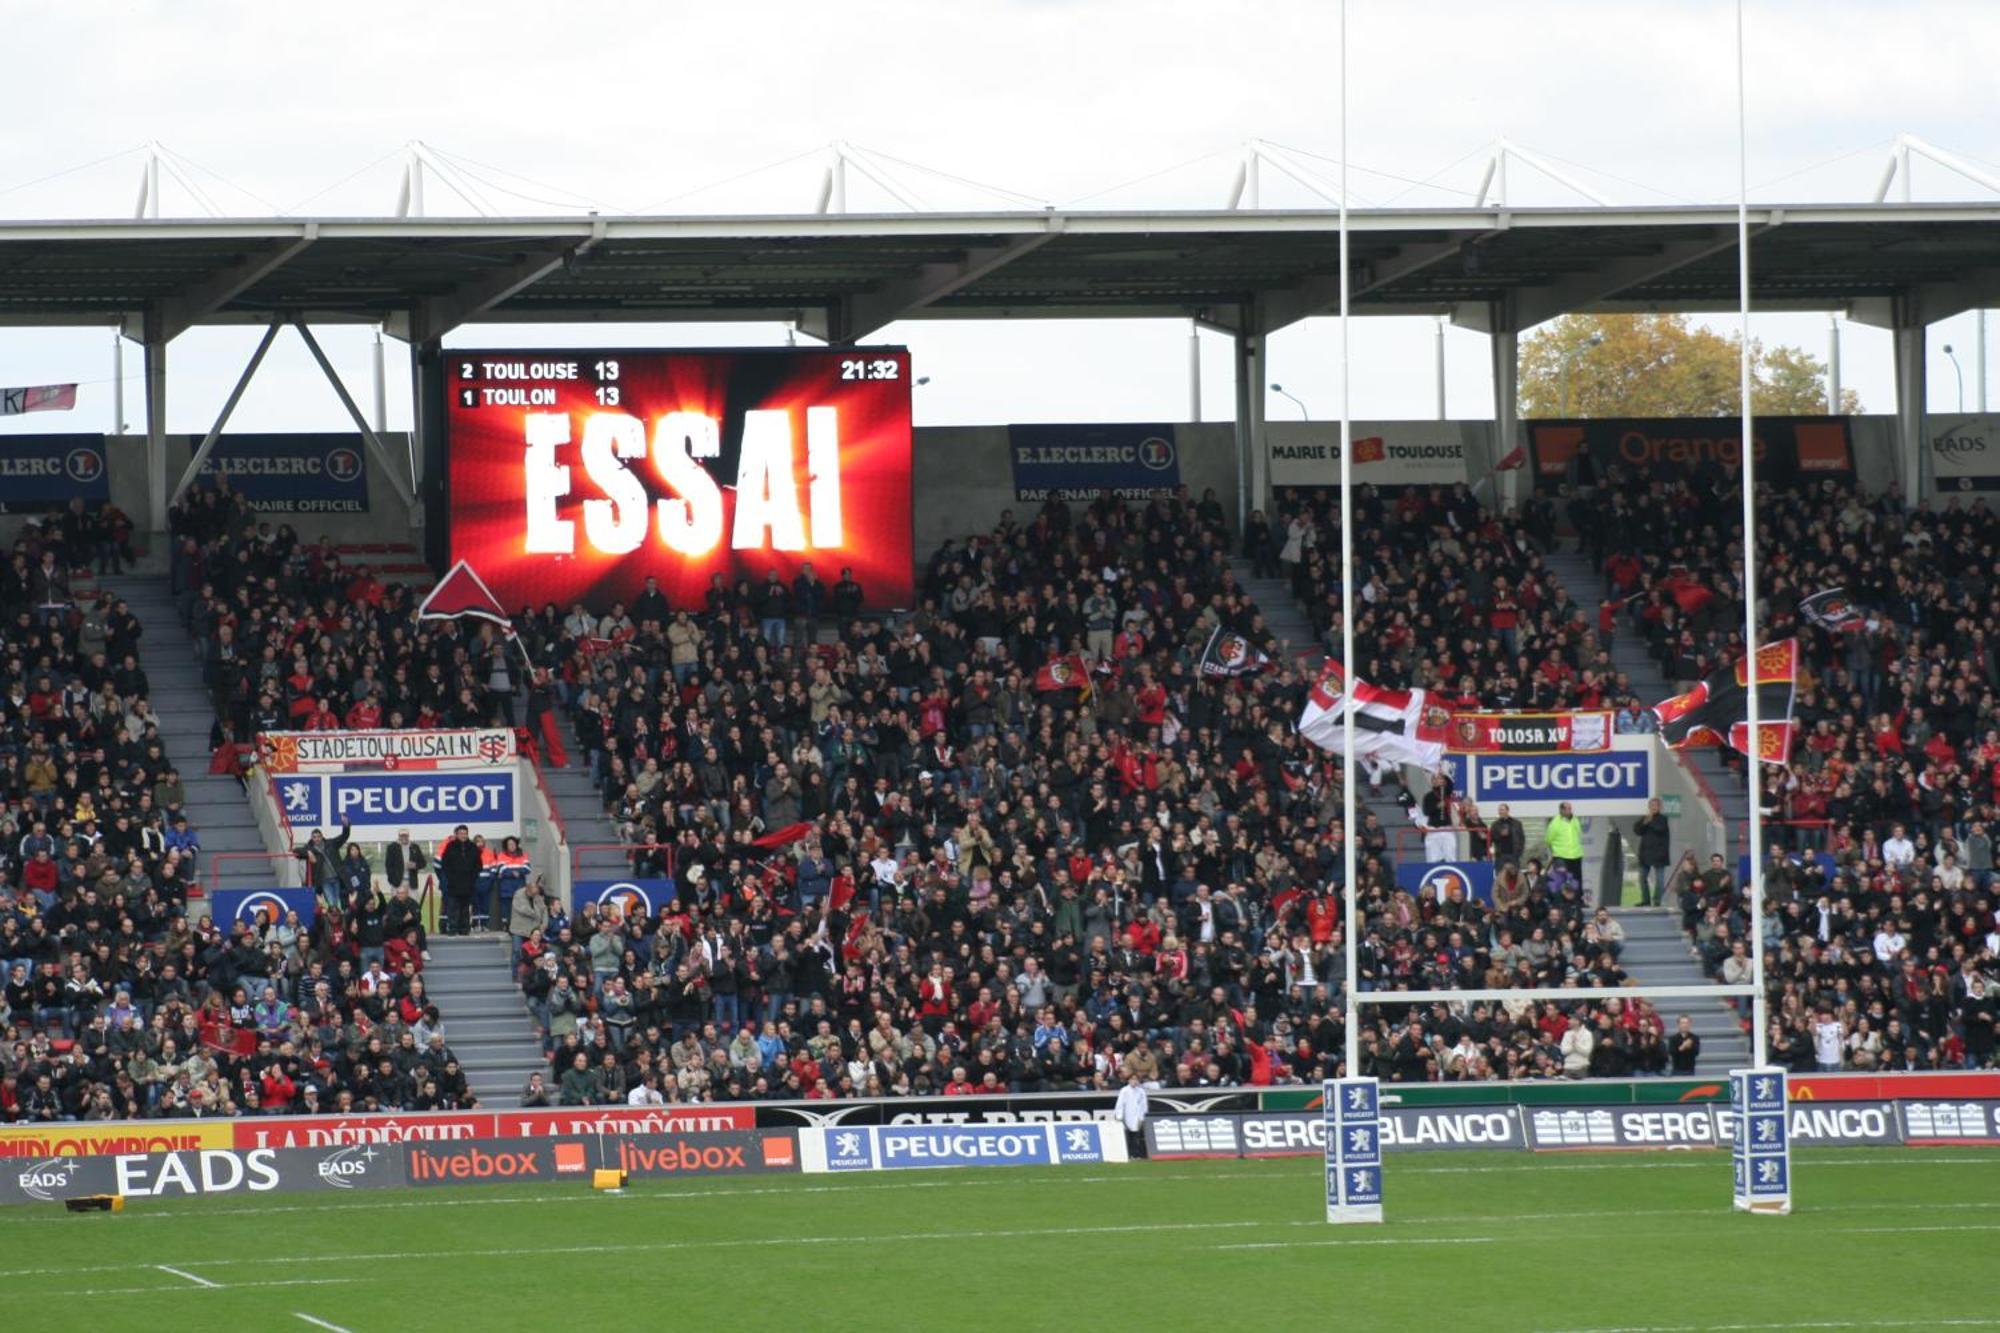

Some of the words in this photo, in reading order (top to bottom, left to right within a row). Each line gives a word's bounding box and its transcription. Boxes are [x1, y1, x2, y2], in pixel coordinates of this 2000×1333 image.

[462, 363, 473, 379] 2
[483, 363, 578, 379] TOULOUSE
[595, 361, 619, 380] 13
[841, 360, 898, 379] 21:32
[464, 390, 472, 406] 1
[483, 388, 555, 405] TOULON
[595, 387, 619, 405] 13
[1271, 446, 1326, 459] MAIRIE
[1330, 446, 1342, 459] D
[1387, 445, 1462, 459] TOULOUSE
[1932, 437, 1985, 451] EADS
[1018, 446, 1136, 463] E.LECLERC
[201, 457, 321, 475] E.LECLERC
[525, 406, 843, 555] ESSAI
[297, 500, 362, 511] OFFICIEL
[1547, 727, 1569, 743] XV
[1482, 762, 1642, 790] PEUGEOT
[337, 785, 506, 813] PEUGEOT
[288, 814, 318, 822] UGEOT
[1243, 1119, 1326, 1148] SERG
[1378, 1114, 1511, 1145] BLANCO
[1786, 1108, 1886, 1139] ANCO
[618, 1140, 746, 1172] livebox
[885, 1135, 1041, 1158] PEUGEOT
[1062, 1152, 1099, 1160] PEUGEOT
[115, 1149, 280, 1196] EADS
[318, 1161, 366, 1177] EADS
[412, 1148, 538, 1179] livebox
[19, 1173, 67, 1187] EADS
